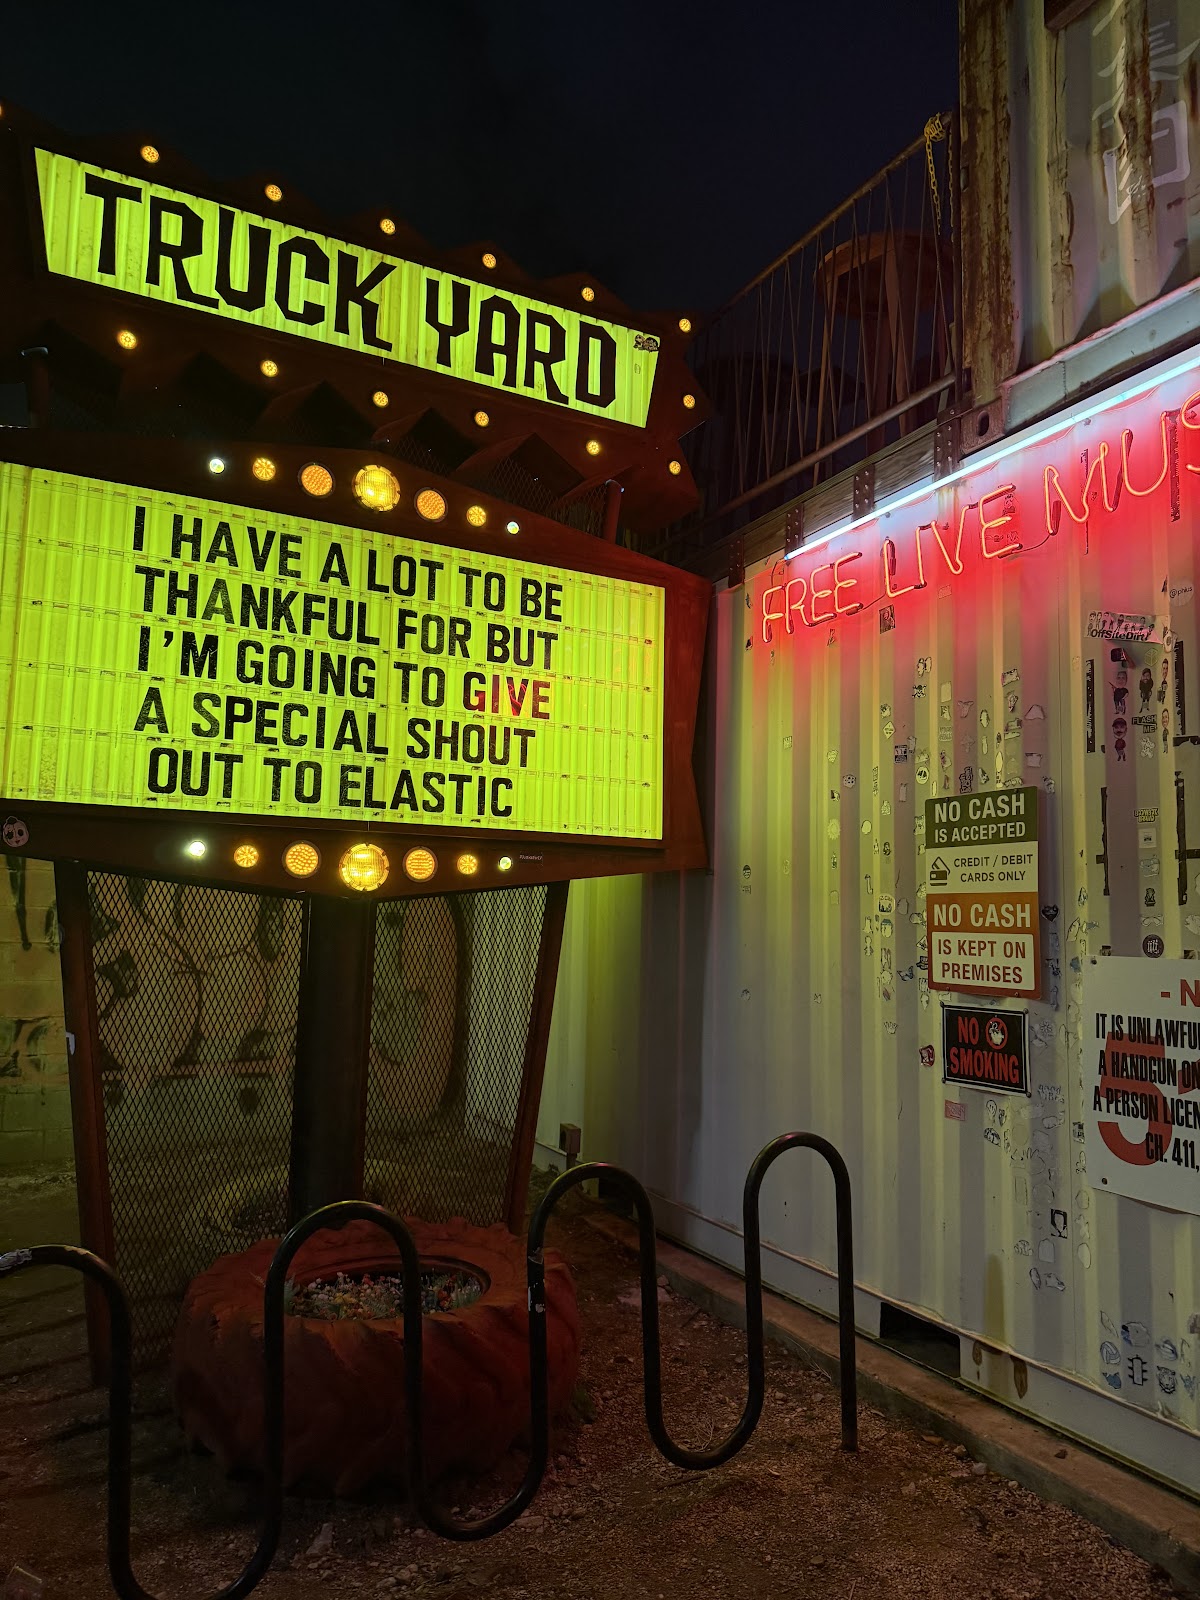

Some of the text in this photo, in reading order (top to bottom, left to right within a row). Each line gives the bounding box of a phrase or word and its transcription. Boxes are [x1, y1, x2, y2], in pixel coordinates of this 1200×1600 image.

[85, 172, 616, 408] TRUCK YARD
[133, 506, 563, 622] I HAVE A LOT TO BE
[762, 552, 862, 642] FREE
[884, 484, 1021, 598] LIVE
[135, 565, 559, 670] THANKFUL FOR BUT
[138, 626, 550, 719] I'M GOING TO GIVE
[134, 687, 536, 767] A SPECIAL SHOUT
[1132, 714, 1157, 725] FLASH
[1143, 725, 1156, 733] ME
[148, 747, 513, 817] OUT TO ELASTIC
[934, 793, 1025, 823] NO CASH
[934, 821, 1026, 843] IS ACCEPTED
[953, 853, 1033, 868] CREDIT / DEBIT
[960, 870, 1026, 882] CARDS ONLY
[933, 903, 1031, 928] NO CASH
[938, 939, 1026, 959] IS KEPT ON
[941, 962, 1023, 984] PREMISES
[957, 1015, 980, 1045] NO
[1096, 1013, 1200, 1050] IT IS UNLAWFU
[949, 1046, 1020, 1084] SMOKING
[1098, 1050, 1107, 1077] A
[1111, 1051, 1177, 1087] HANDGUN
[1093, 1086, 1103, 1112] A
[1106, 1088, 1158, 1120] PERSON
[1146, 1132, 1200, 1173] CH. 411,
